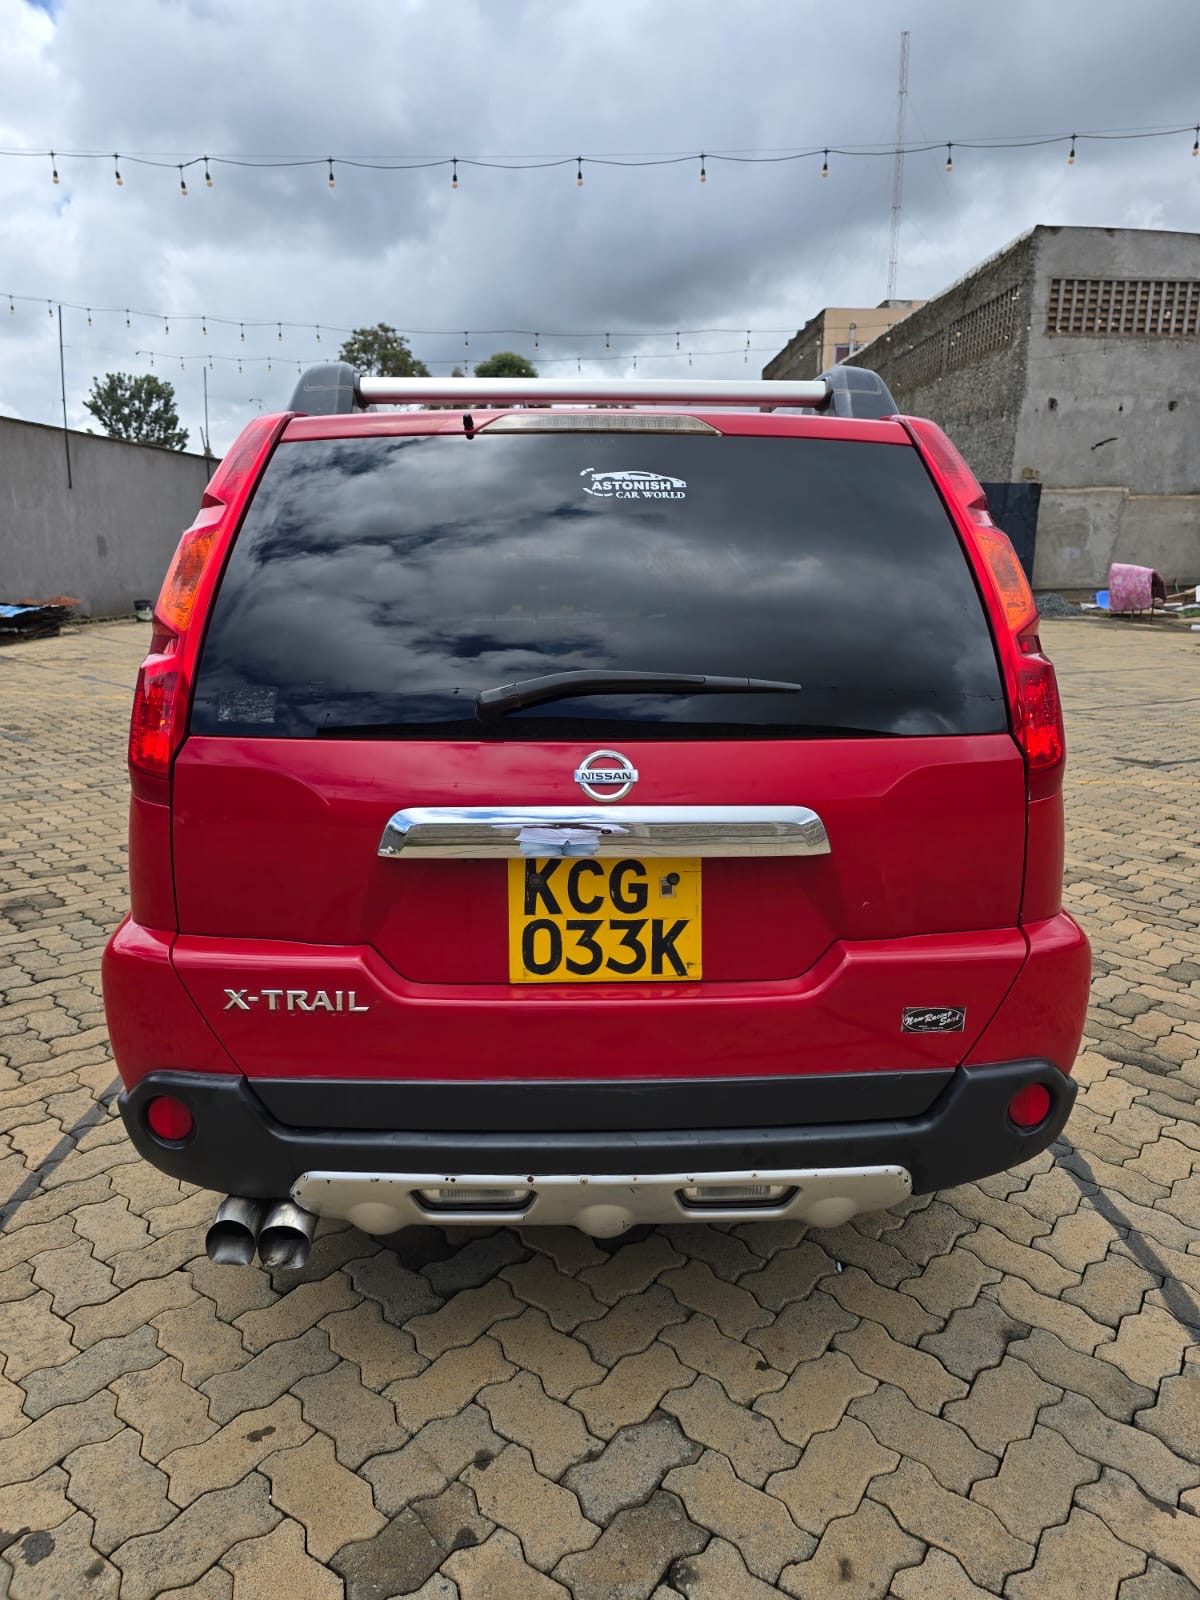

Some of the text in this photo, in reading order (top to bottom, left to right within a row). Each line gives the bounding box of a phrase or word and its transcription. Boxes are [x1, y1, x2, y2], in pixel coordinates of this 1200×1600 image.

[592, 481, 671, 490] ASTONISH
[616, 491, 686, 499] CAR WORLD
[581, 772, 632, 780] NISSAN
[524, 857, 648, 915] KCG
[522, 918, 690, 976] 033K
[223, 989, 370, 1012] X-TRAIL
